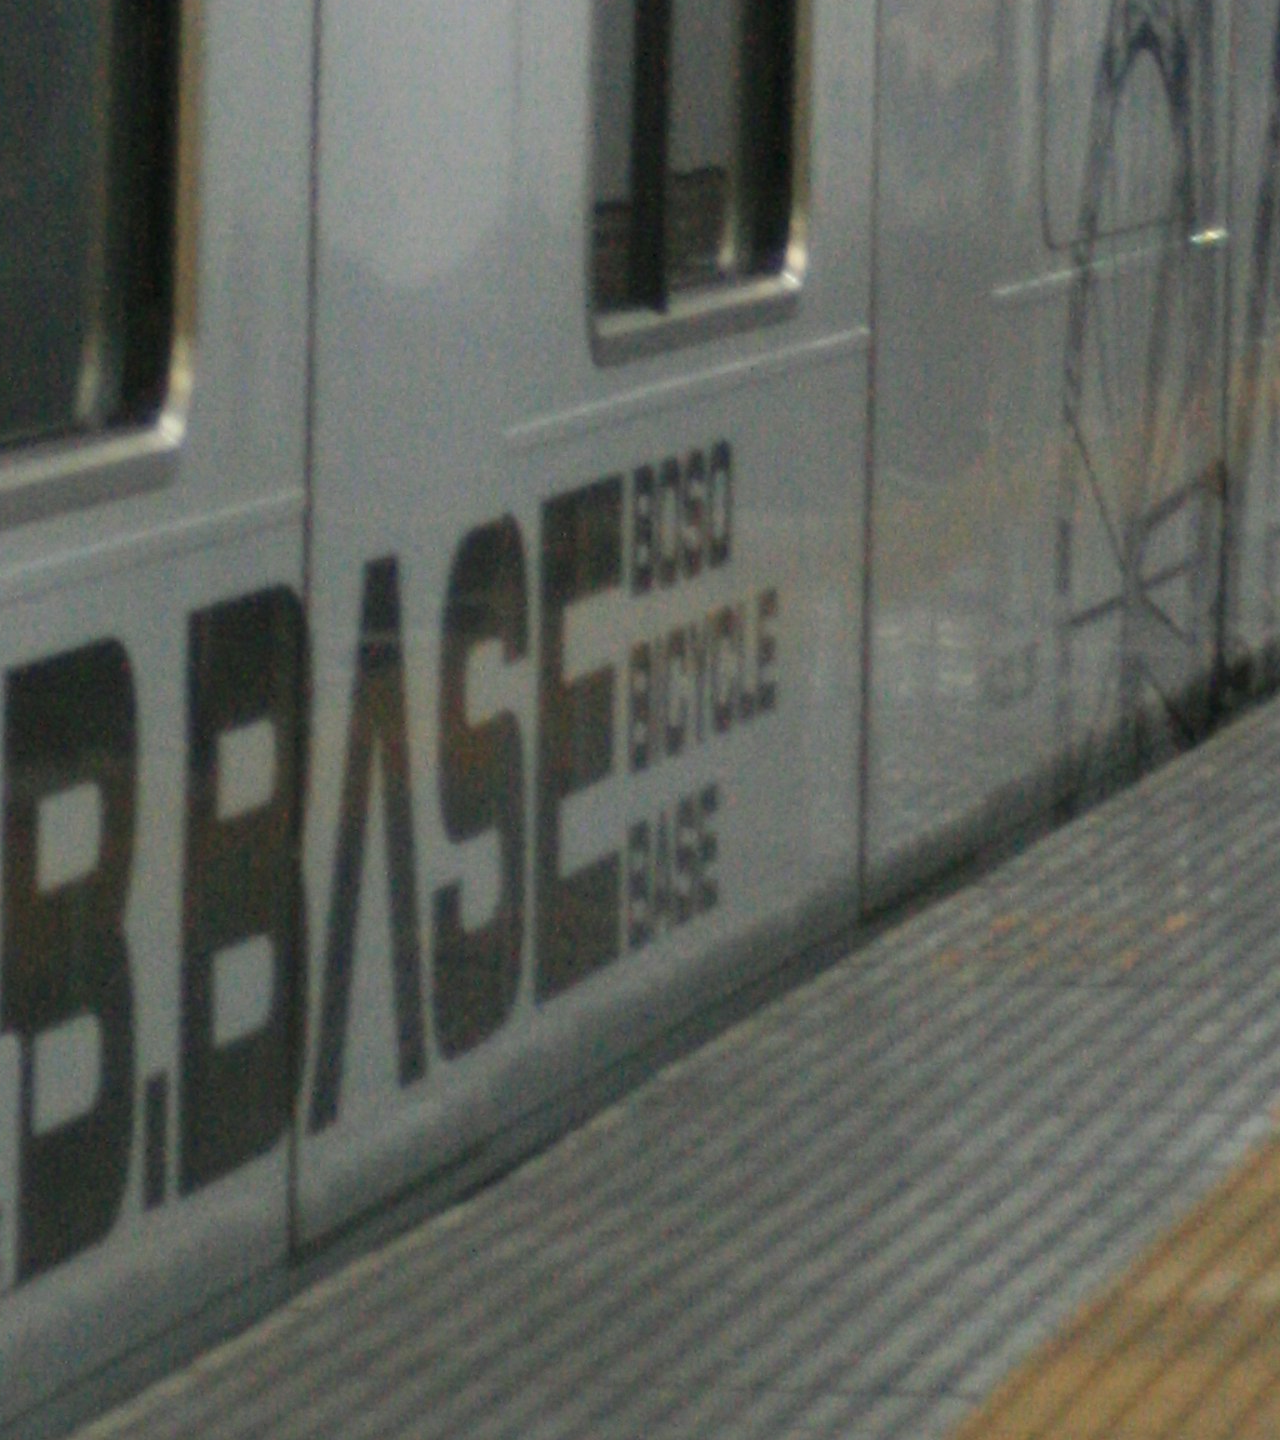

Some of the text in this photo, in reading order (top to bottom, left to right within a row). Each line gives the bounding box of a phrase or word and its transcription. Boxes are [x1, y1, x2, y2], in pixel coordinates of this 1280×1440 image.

[630, 438, 732, 595] BOSO
[629, 586, 778, 776] BICYCLE
[627, 783, 719, 949] BASE
